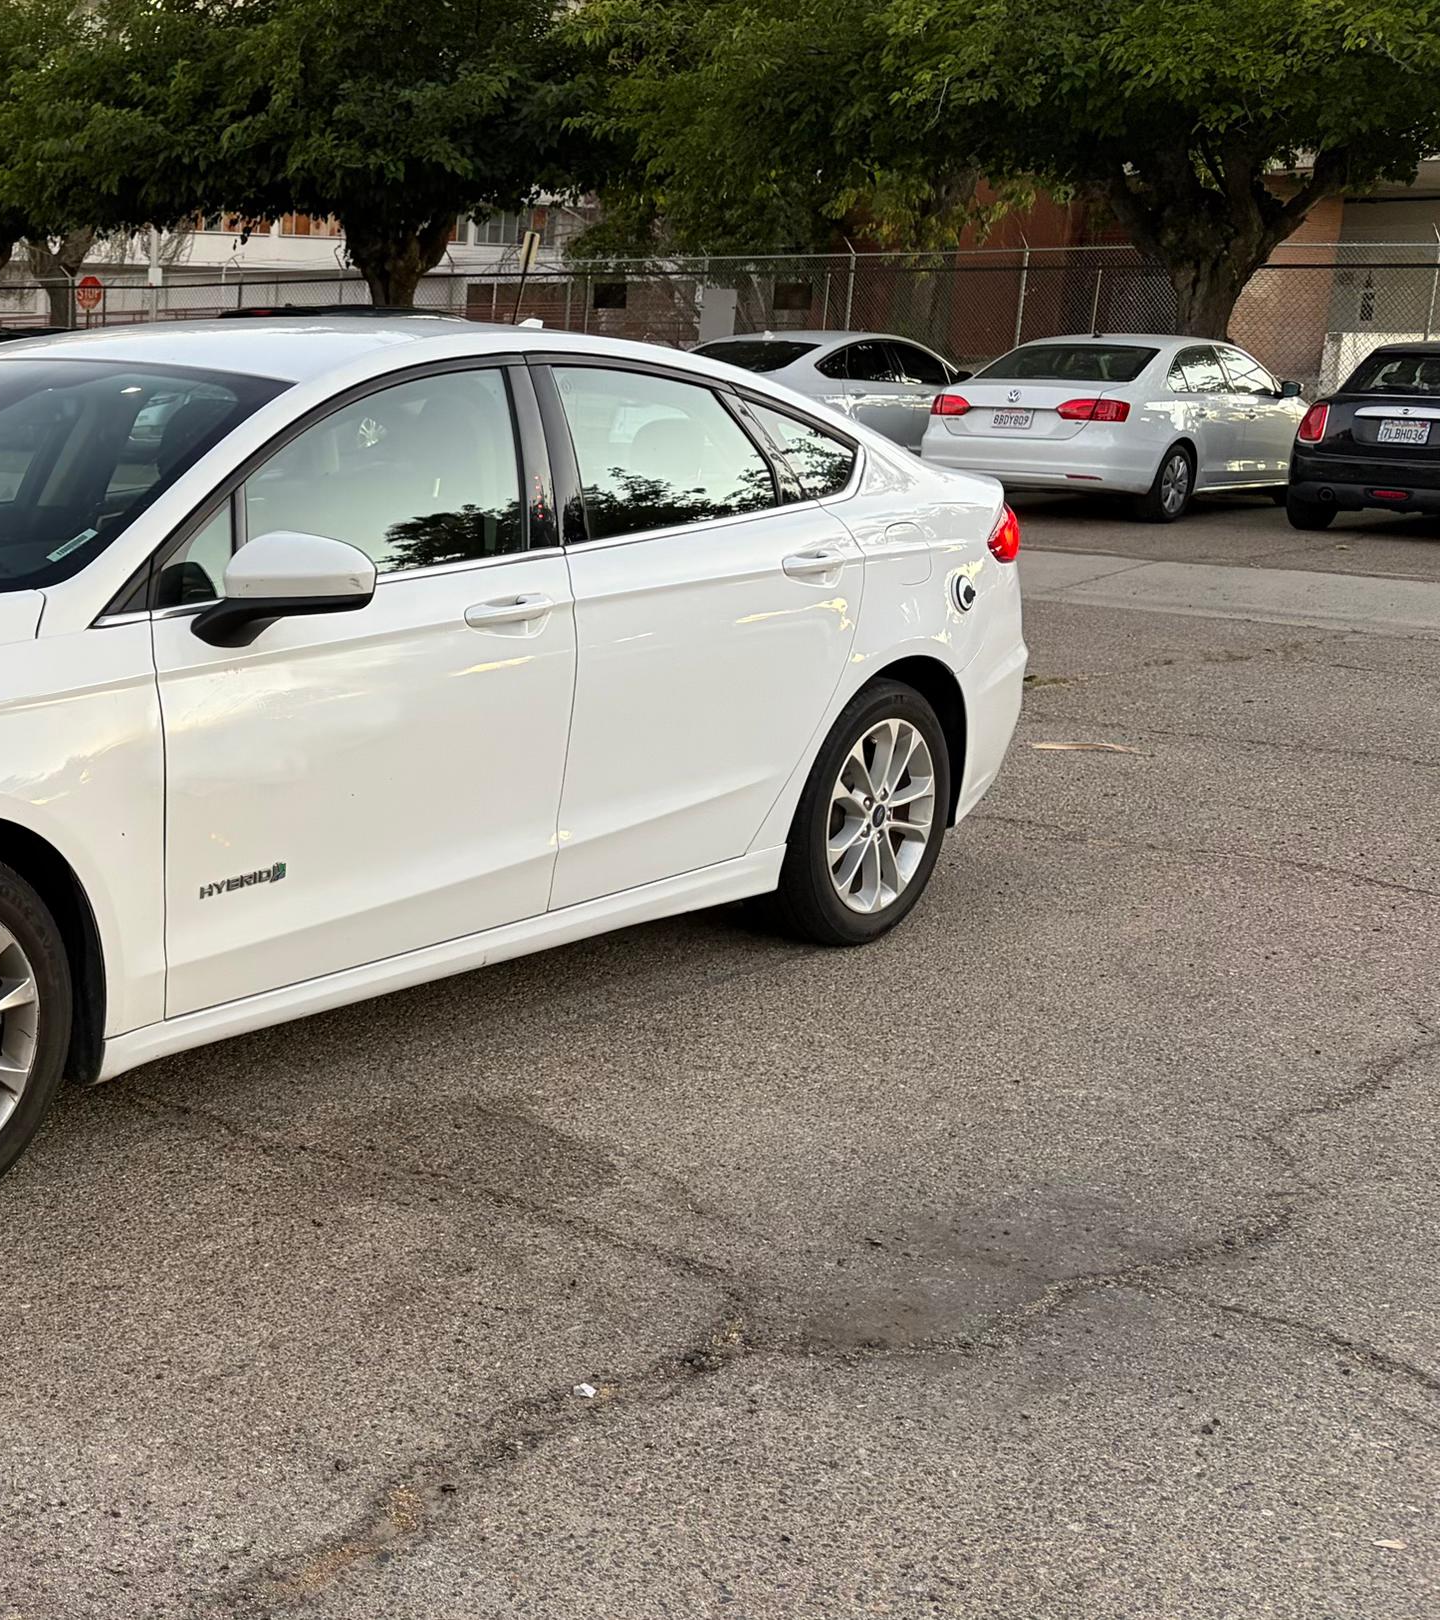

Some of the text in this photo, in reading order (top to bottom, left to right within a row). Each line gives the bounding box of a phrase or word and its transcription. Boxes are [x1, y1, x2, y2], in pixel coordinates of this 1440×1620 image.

[77, 288, 99, 300] STOP
[993, 414, 1030, 426] 8BDY809
[1383, 427, 1425, 440] 7LBH036
[199, 868, 272, 900] HYBRID
